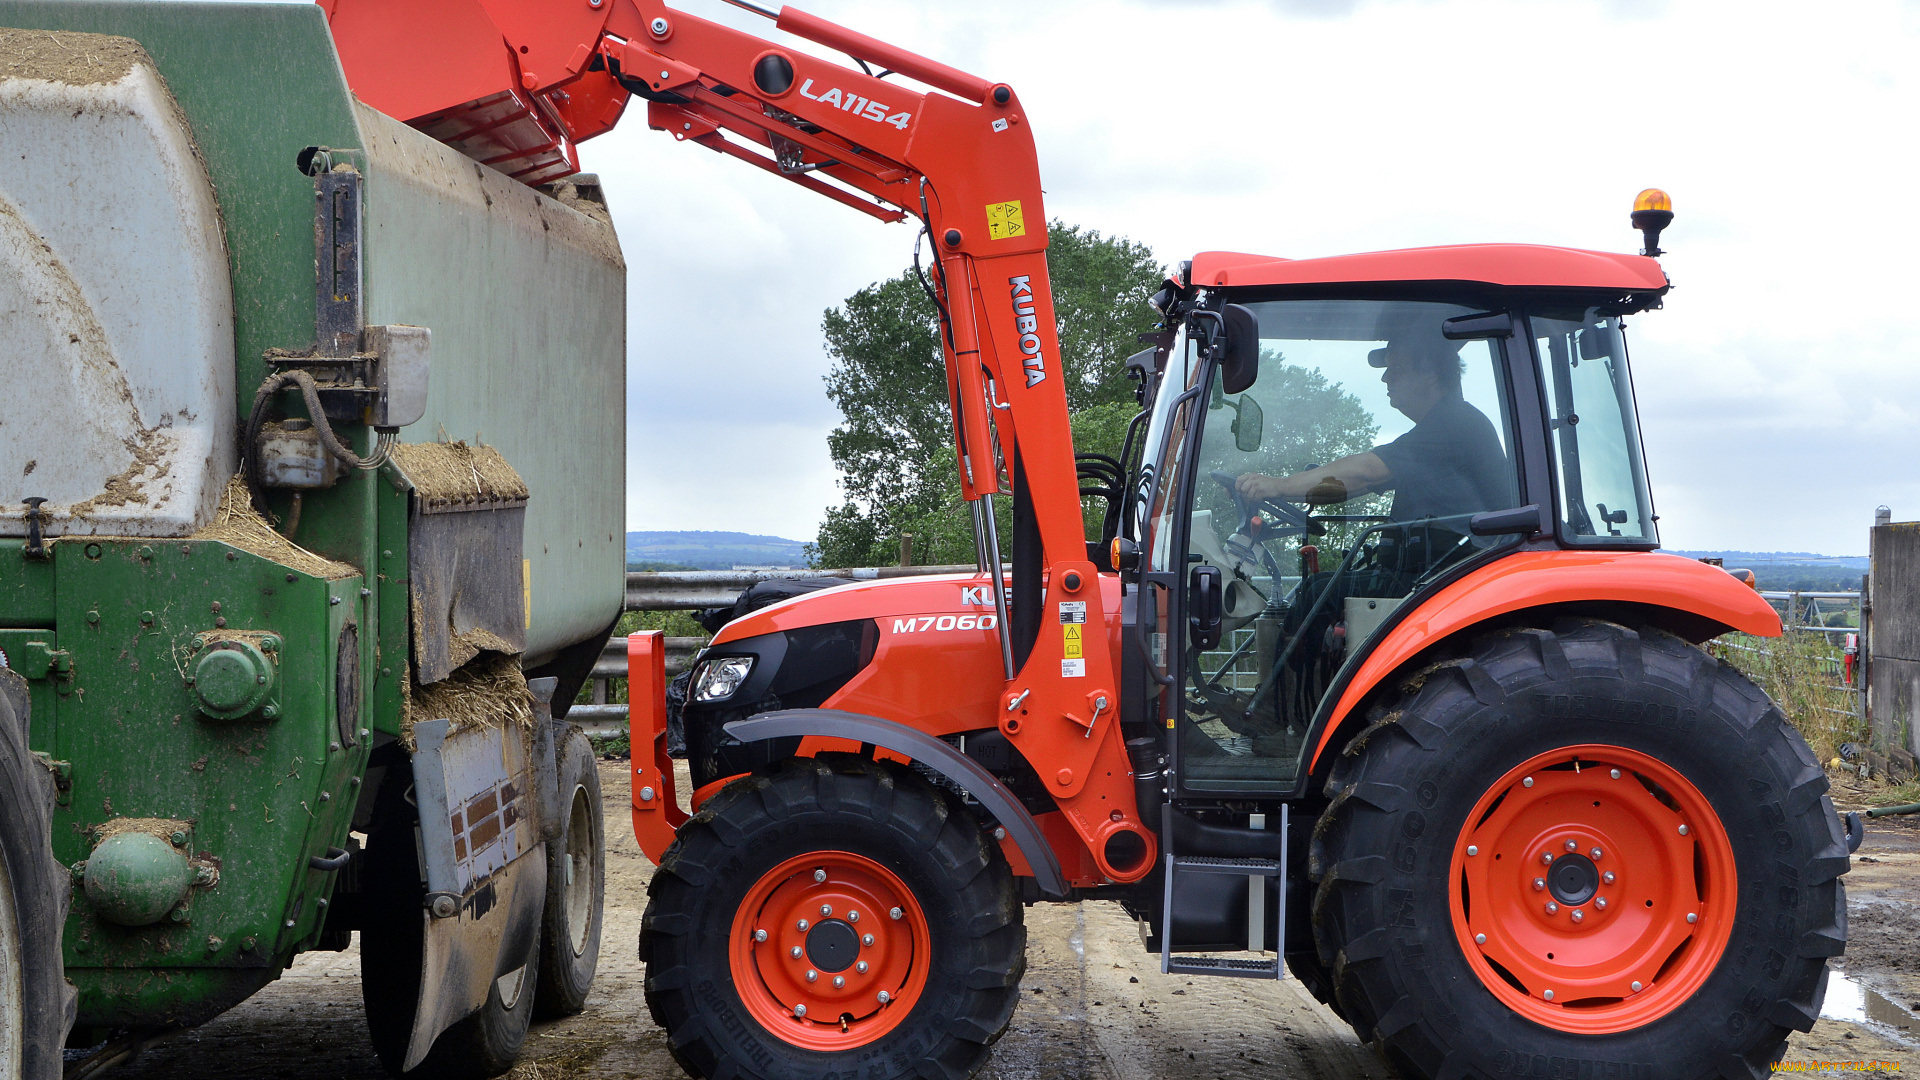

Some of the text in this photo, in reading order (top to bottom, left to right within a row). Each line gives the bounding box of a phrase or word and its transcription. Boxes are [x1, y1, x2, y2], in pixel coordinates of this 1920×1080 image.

[799, 78, 912, 130] LA1154
[1008, 274, 1047, 390] KUBOTA
[892, 615, 999, 634] M7060
[1536, 693, 1698, 732] TRELLEBORG
[978, 745, 998, 758] HOT
[1393, 779, 1440, 875] 600
